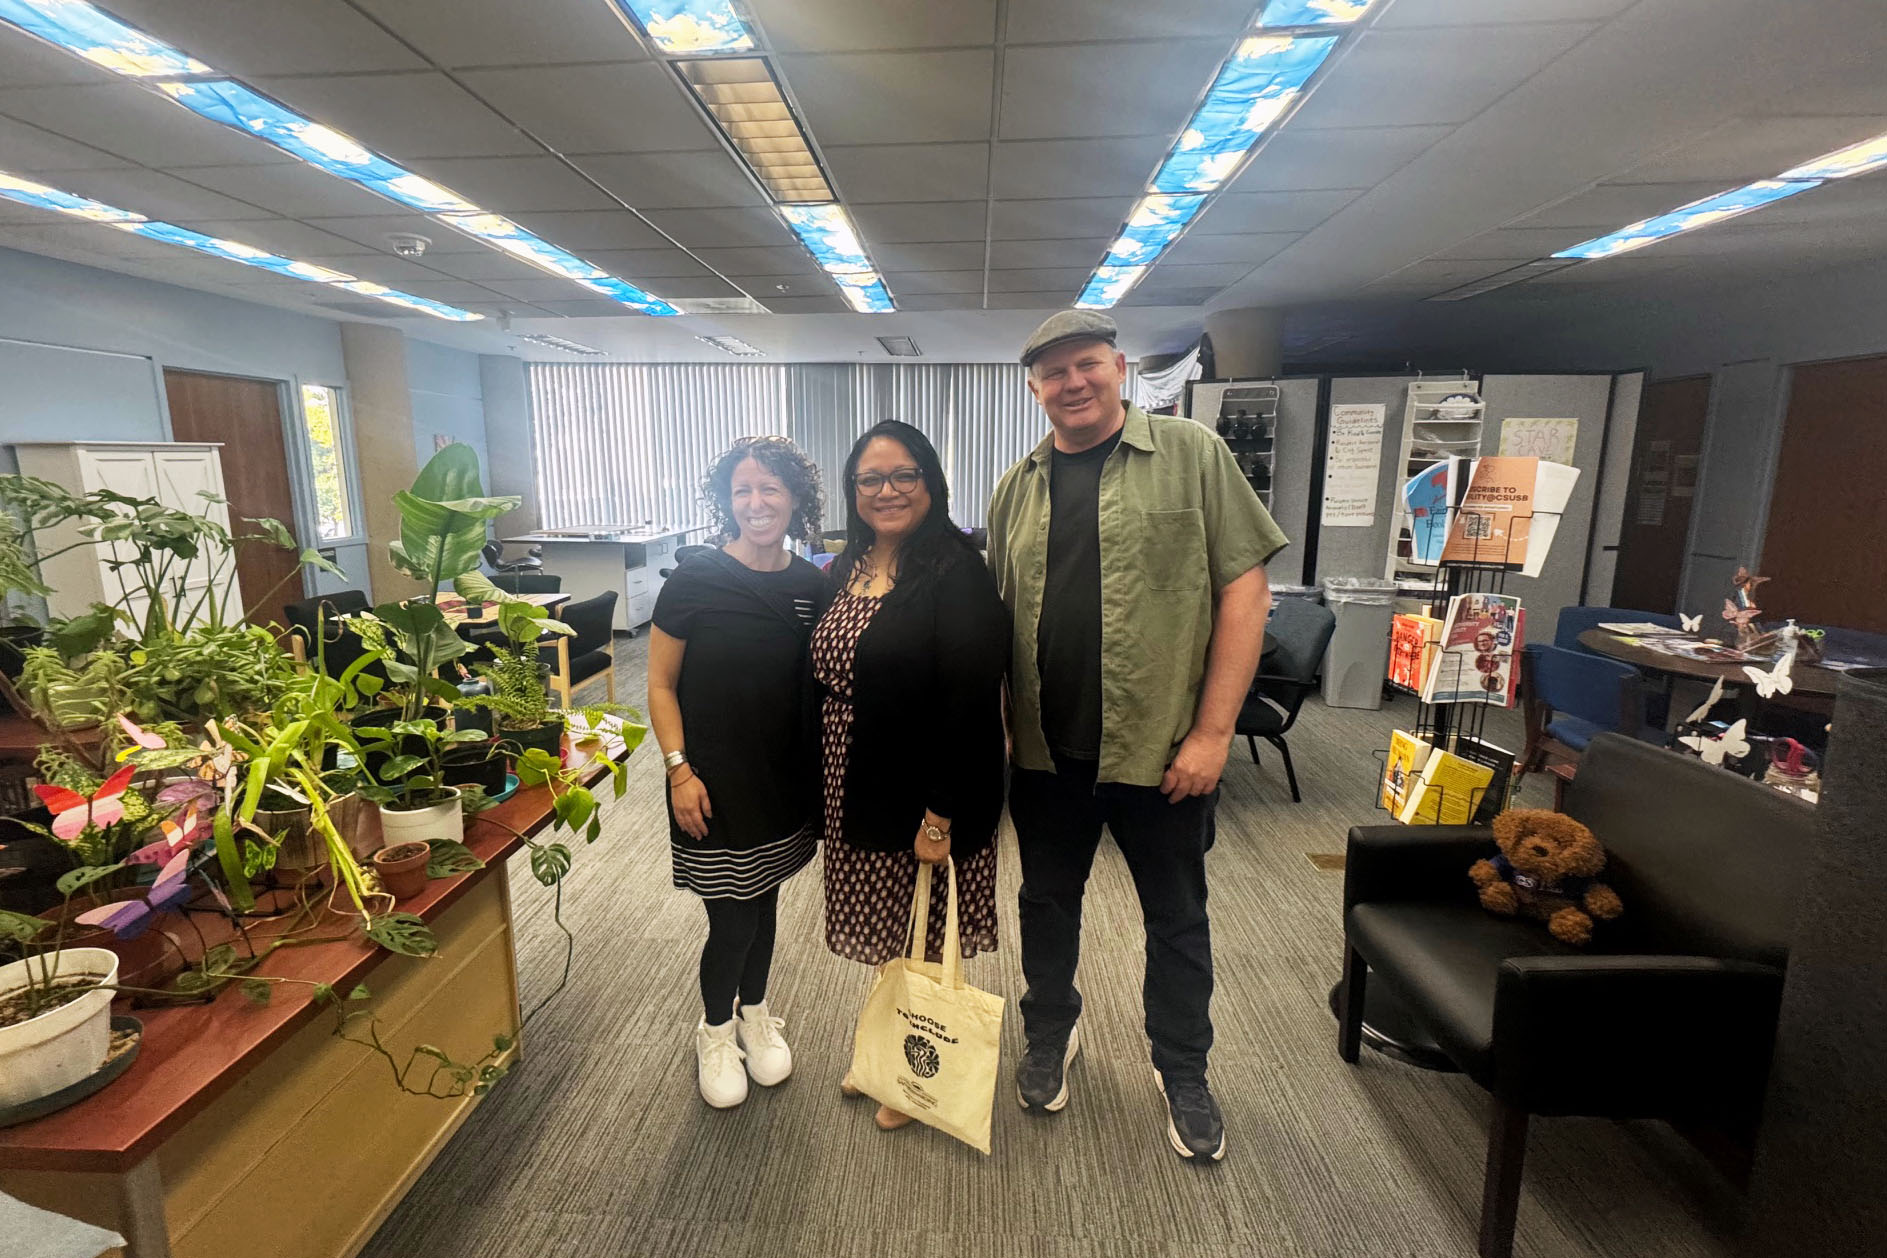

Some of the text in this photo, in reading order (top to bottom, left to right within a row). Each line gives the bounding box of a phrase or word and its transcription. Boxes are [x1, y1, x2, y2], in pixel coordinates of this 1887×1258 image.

[1333, 405, 1374, 417] Community
[1336, 416, 1379, 425] Guidelines
[1512, 426, 1560, 447] STAR
[1503, 486, 1517, 494] TO
[909, 1019, 960, 1044] INCLUDE
